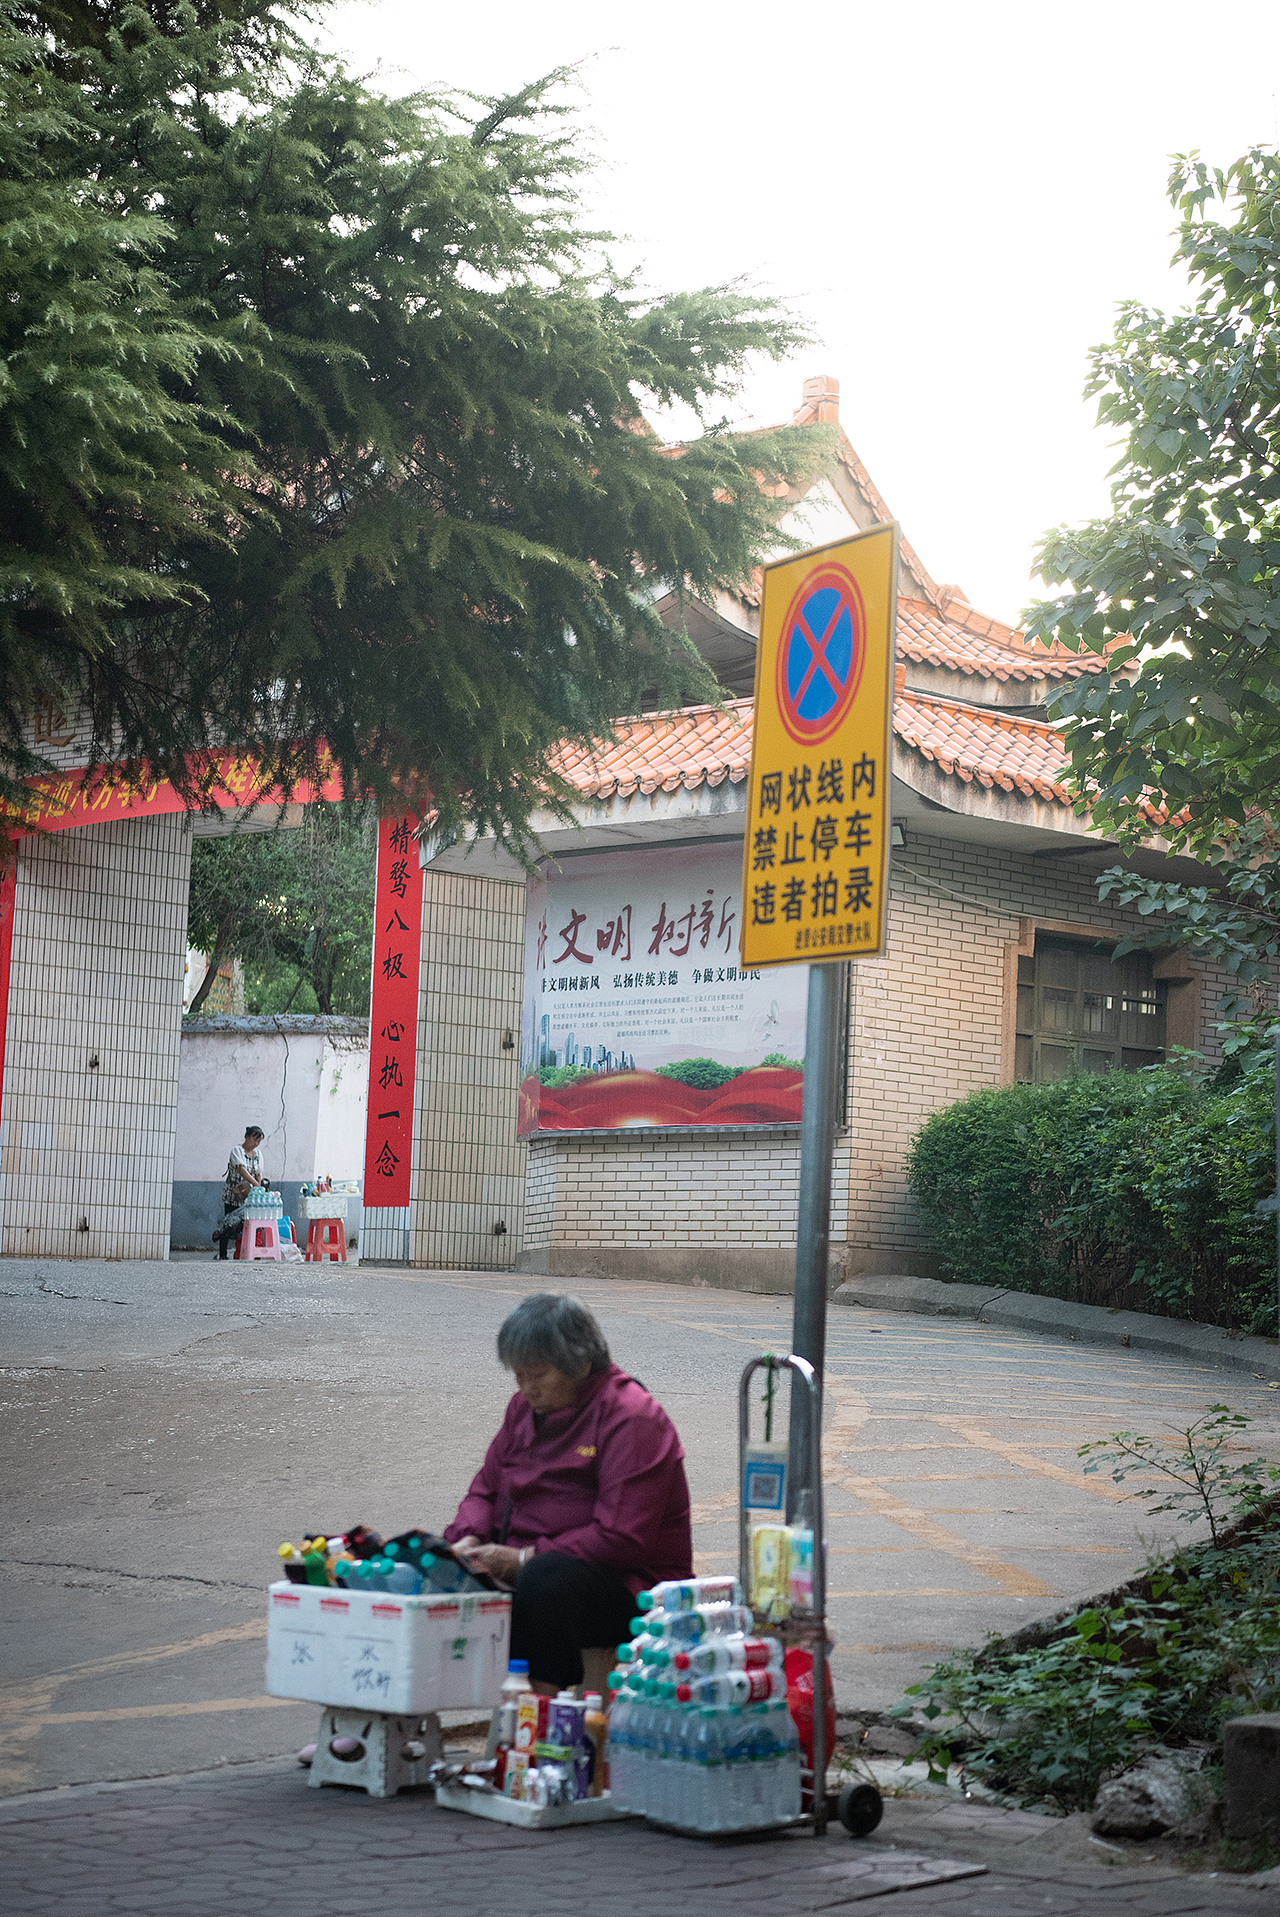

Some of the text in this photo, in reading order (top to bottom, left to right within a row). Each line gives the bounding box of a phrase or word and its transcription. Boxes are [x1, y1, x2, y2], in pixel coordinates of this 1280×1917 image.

[759, 751, 876, 819] 网状线内
[753, 809, 873, 872] 禁止停车
[647, 889, 743, 958] 树新
[752, 866, 874, 927] 违者拍录
[612, 970, 679, 989] 弘扬传统美德
[691, 966, 761, 985] 争做文明市民
[375, 1019, 406, 1178] 心执一念
